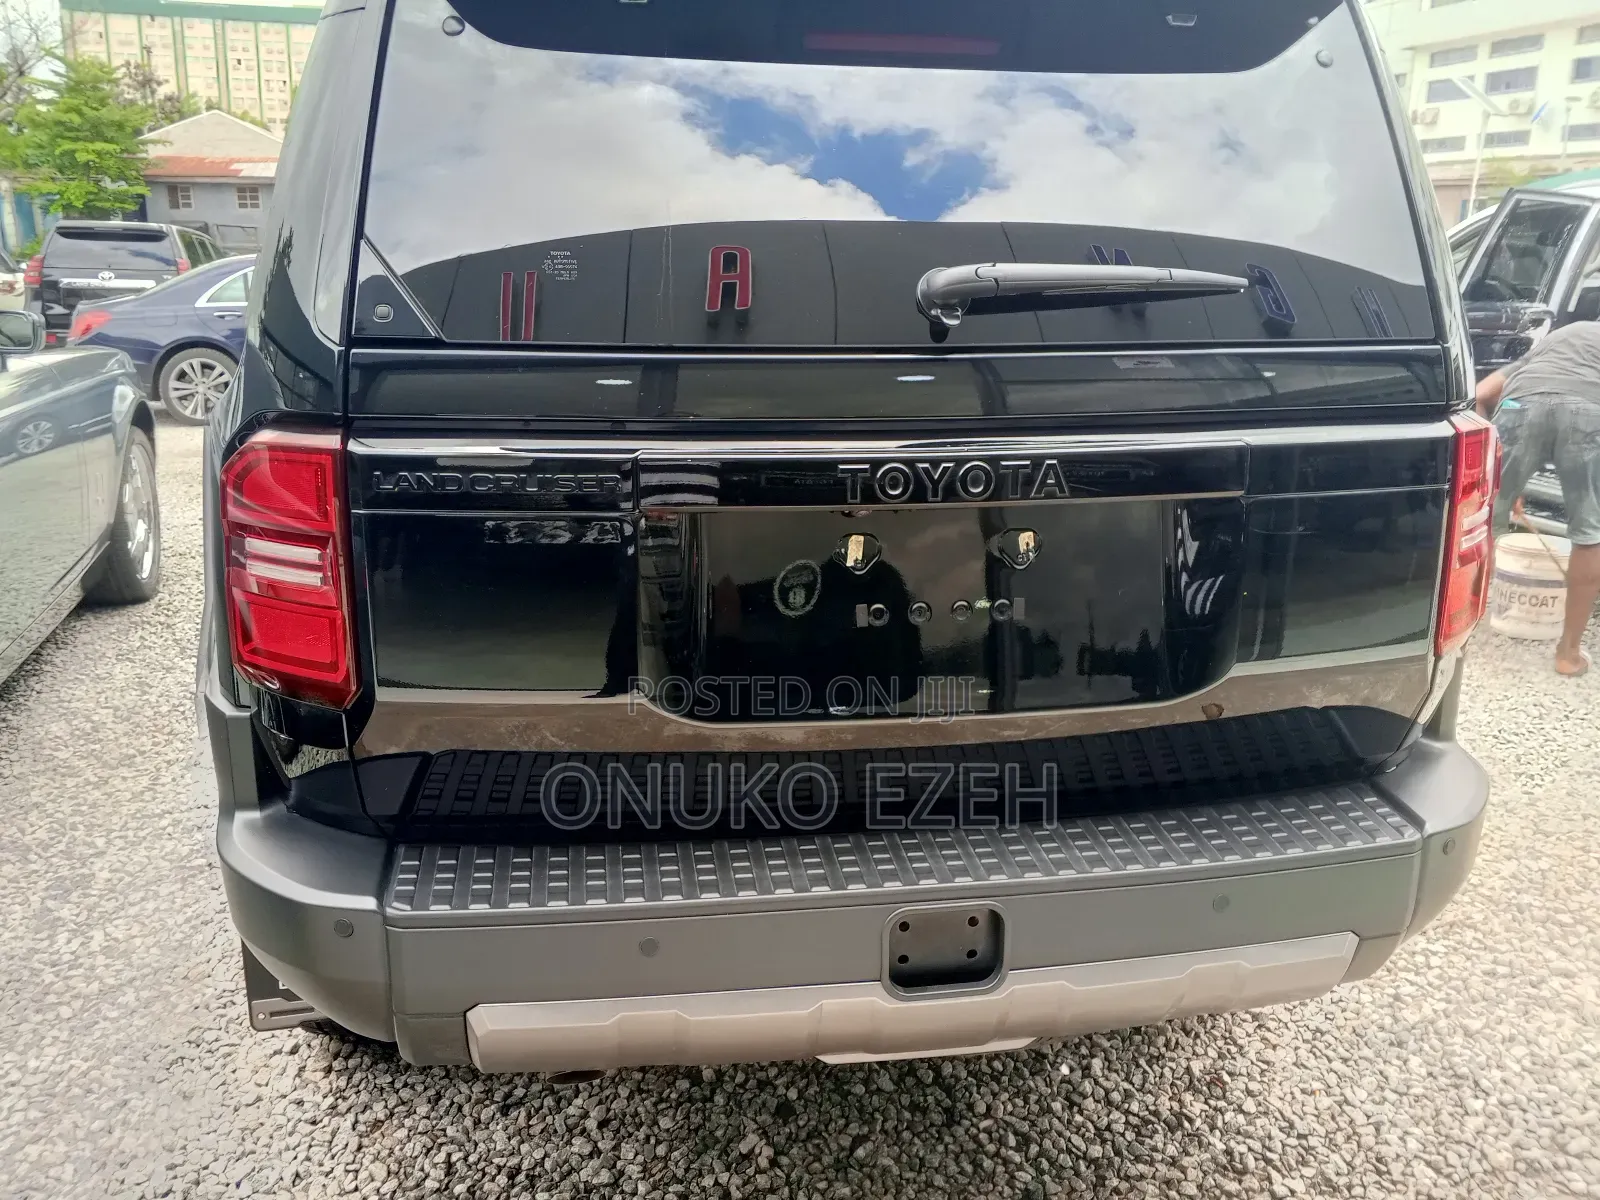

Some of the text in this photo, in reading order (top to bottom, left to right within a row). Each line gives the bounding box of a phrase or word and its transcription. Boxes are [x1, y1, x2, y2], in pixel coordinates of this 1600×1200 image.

[373, 471, 622, 494] LAND CRUISER
[837, 458, 1070, 504] TOYOTA
